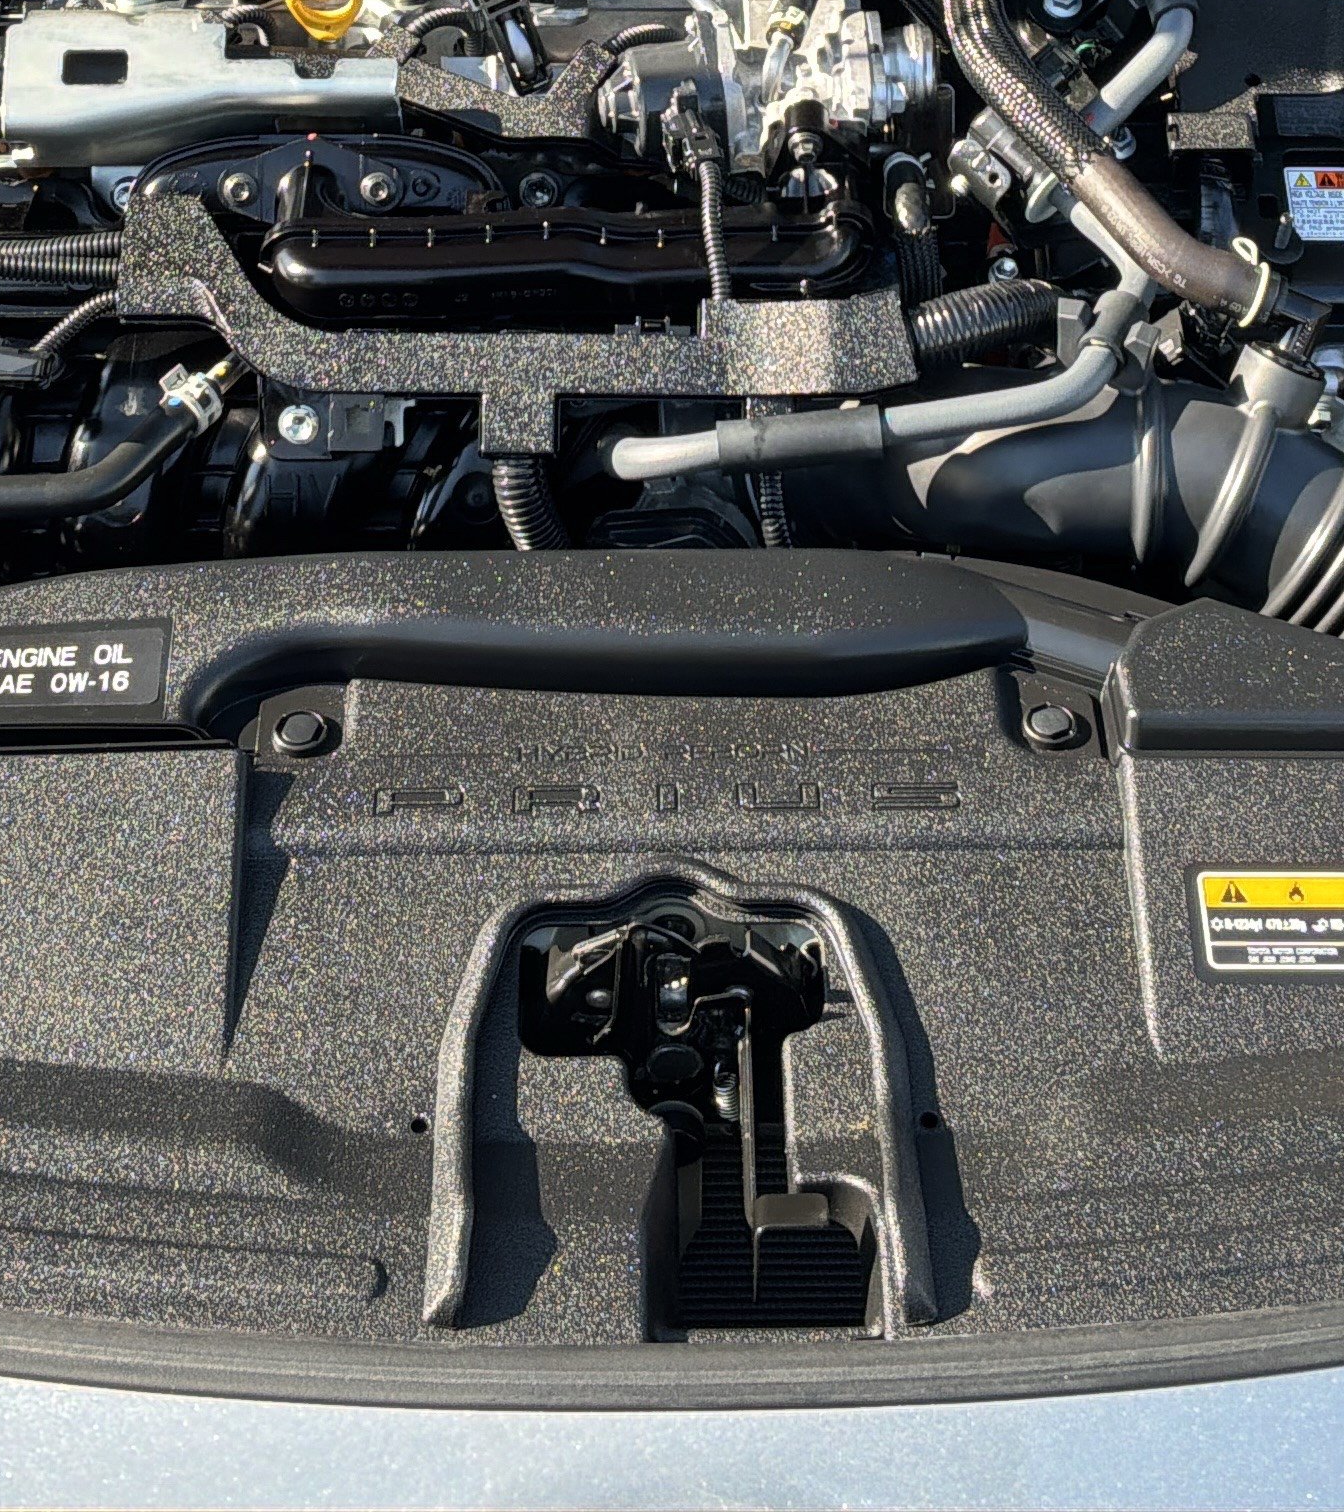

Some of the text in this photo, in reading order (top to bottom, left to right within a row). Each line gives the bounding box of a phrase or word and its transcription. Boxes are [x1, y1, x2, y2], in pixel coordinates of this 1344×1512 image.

[93, 643, 133, 666] OIL
[50, 670, 131, 694] 0W-16
[517, 744, 811, 762] HYBRID REBORN
[373, 782, 961, 815] PRIUS
